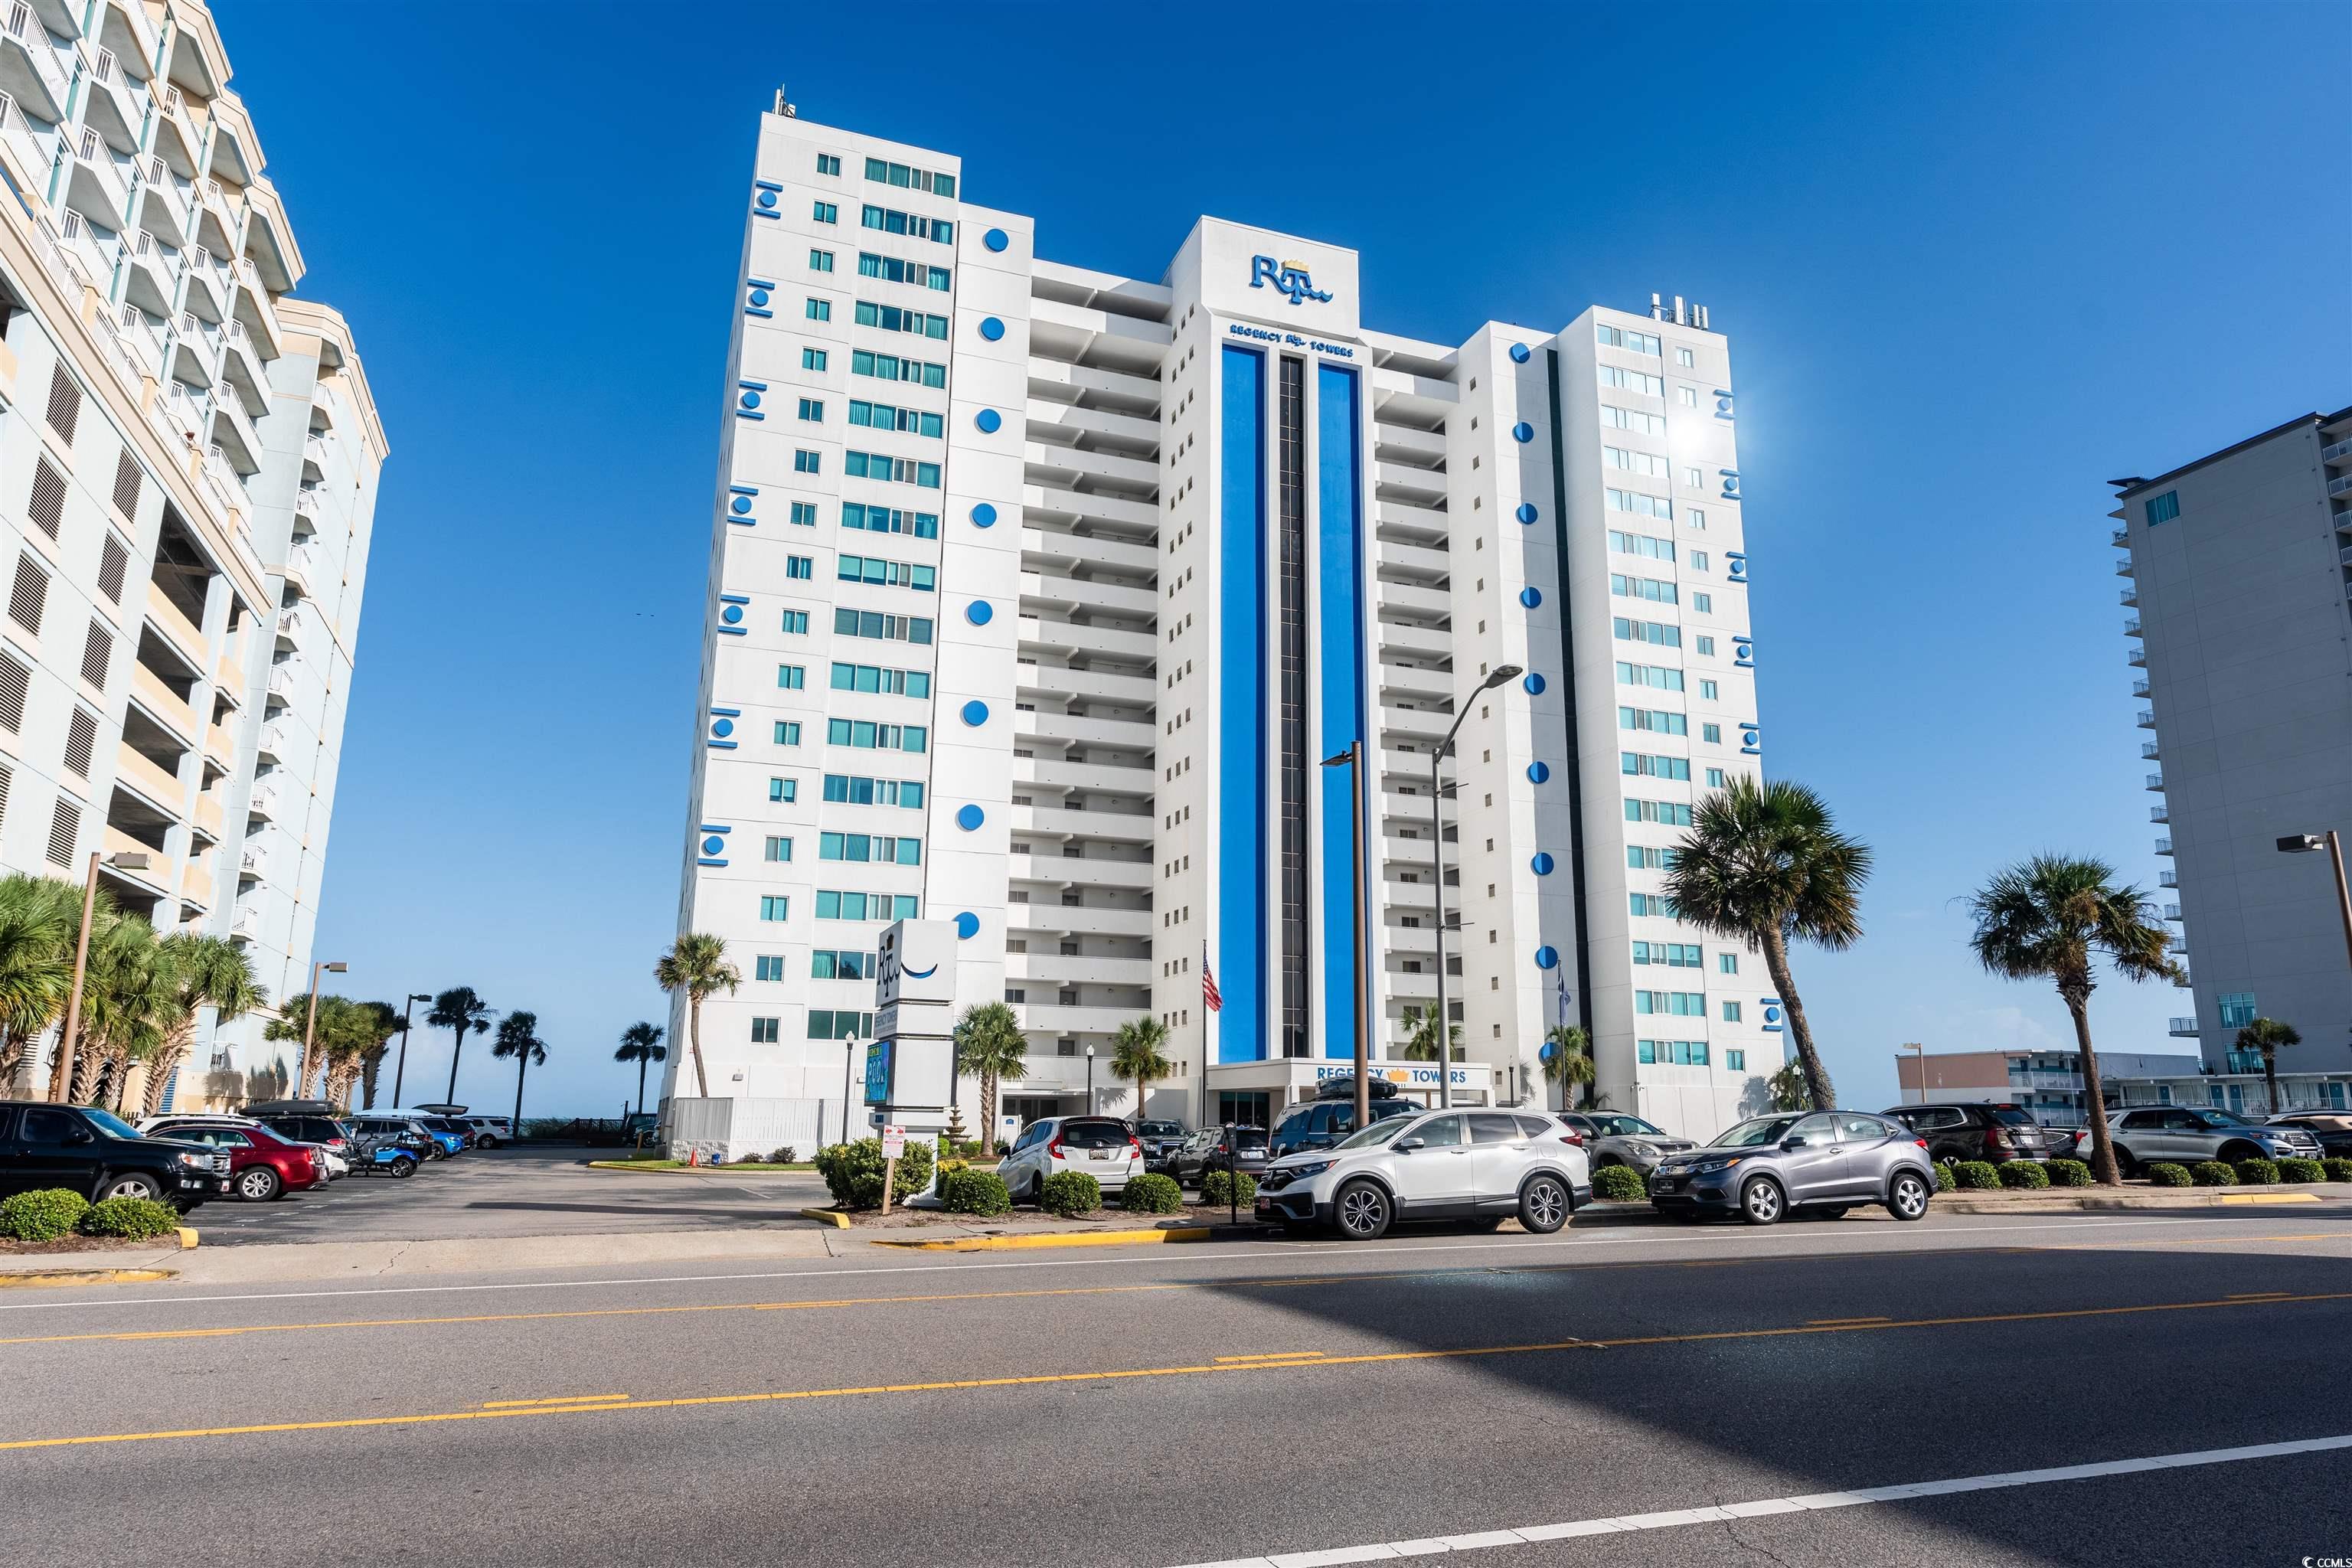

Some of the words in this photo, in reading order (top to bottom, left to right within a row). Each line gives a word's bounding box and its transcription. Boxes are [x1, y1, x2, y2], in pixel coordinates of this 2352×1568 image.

[1230, 324, 1282, 343] REGENCY
[1310, 341, 1354, 358] TOWERS
[1317, 1067, 1383, 1080] REGEY
[1413, 1070, 1466, 1083] TOWRS
